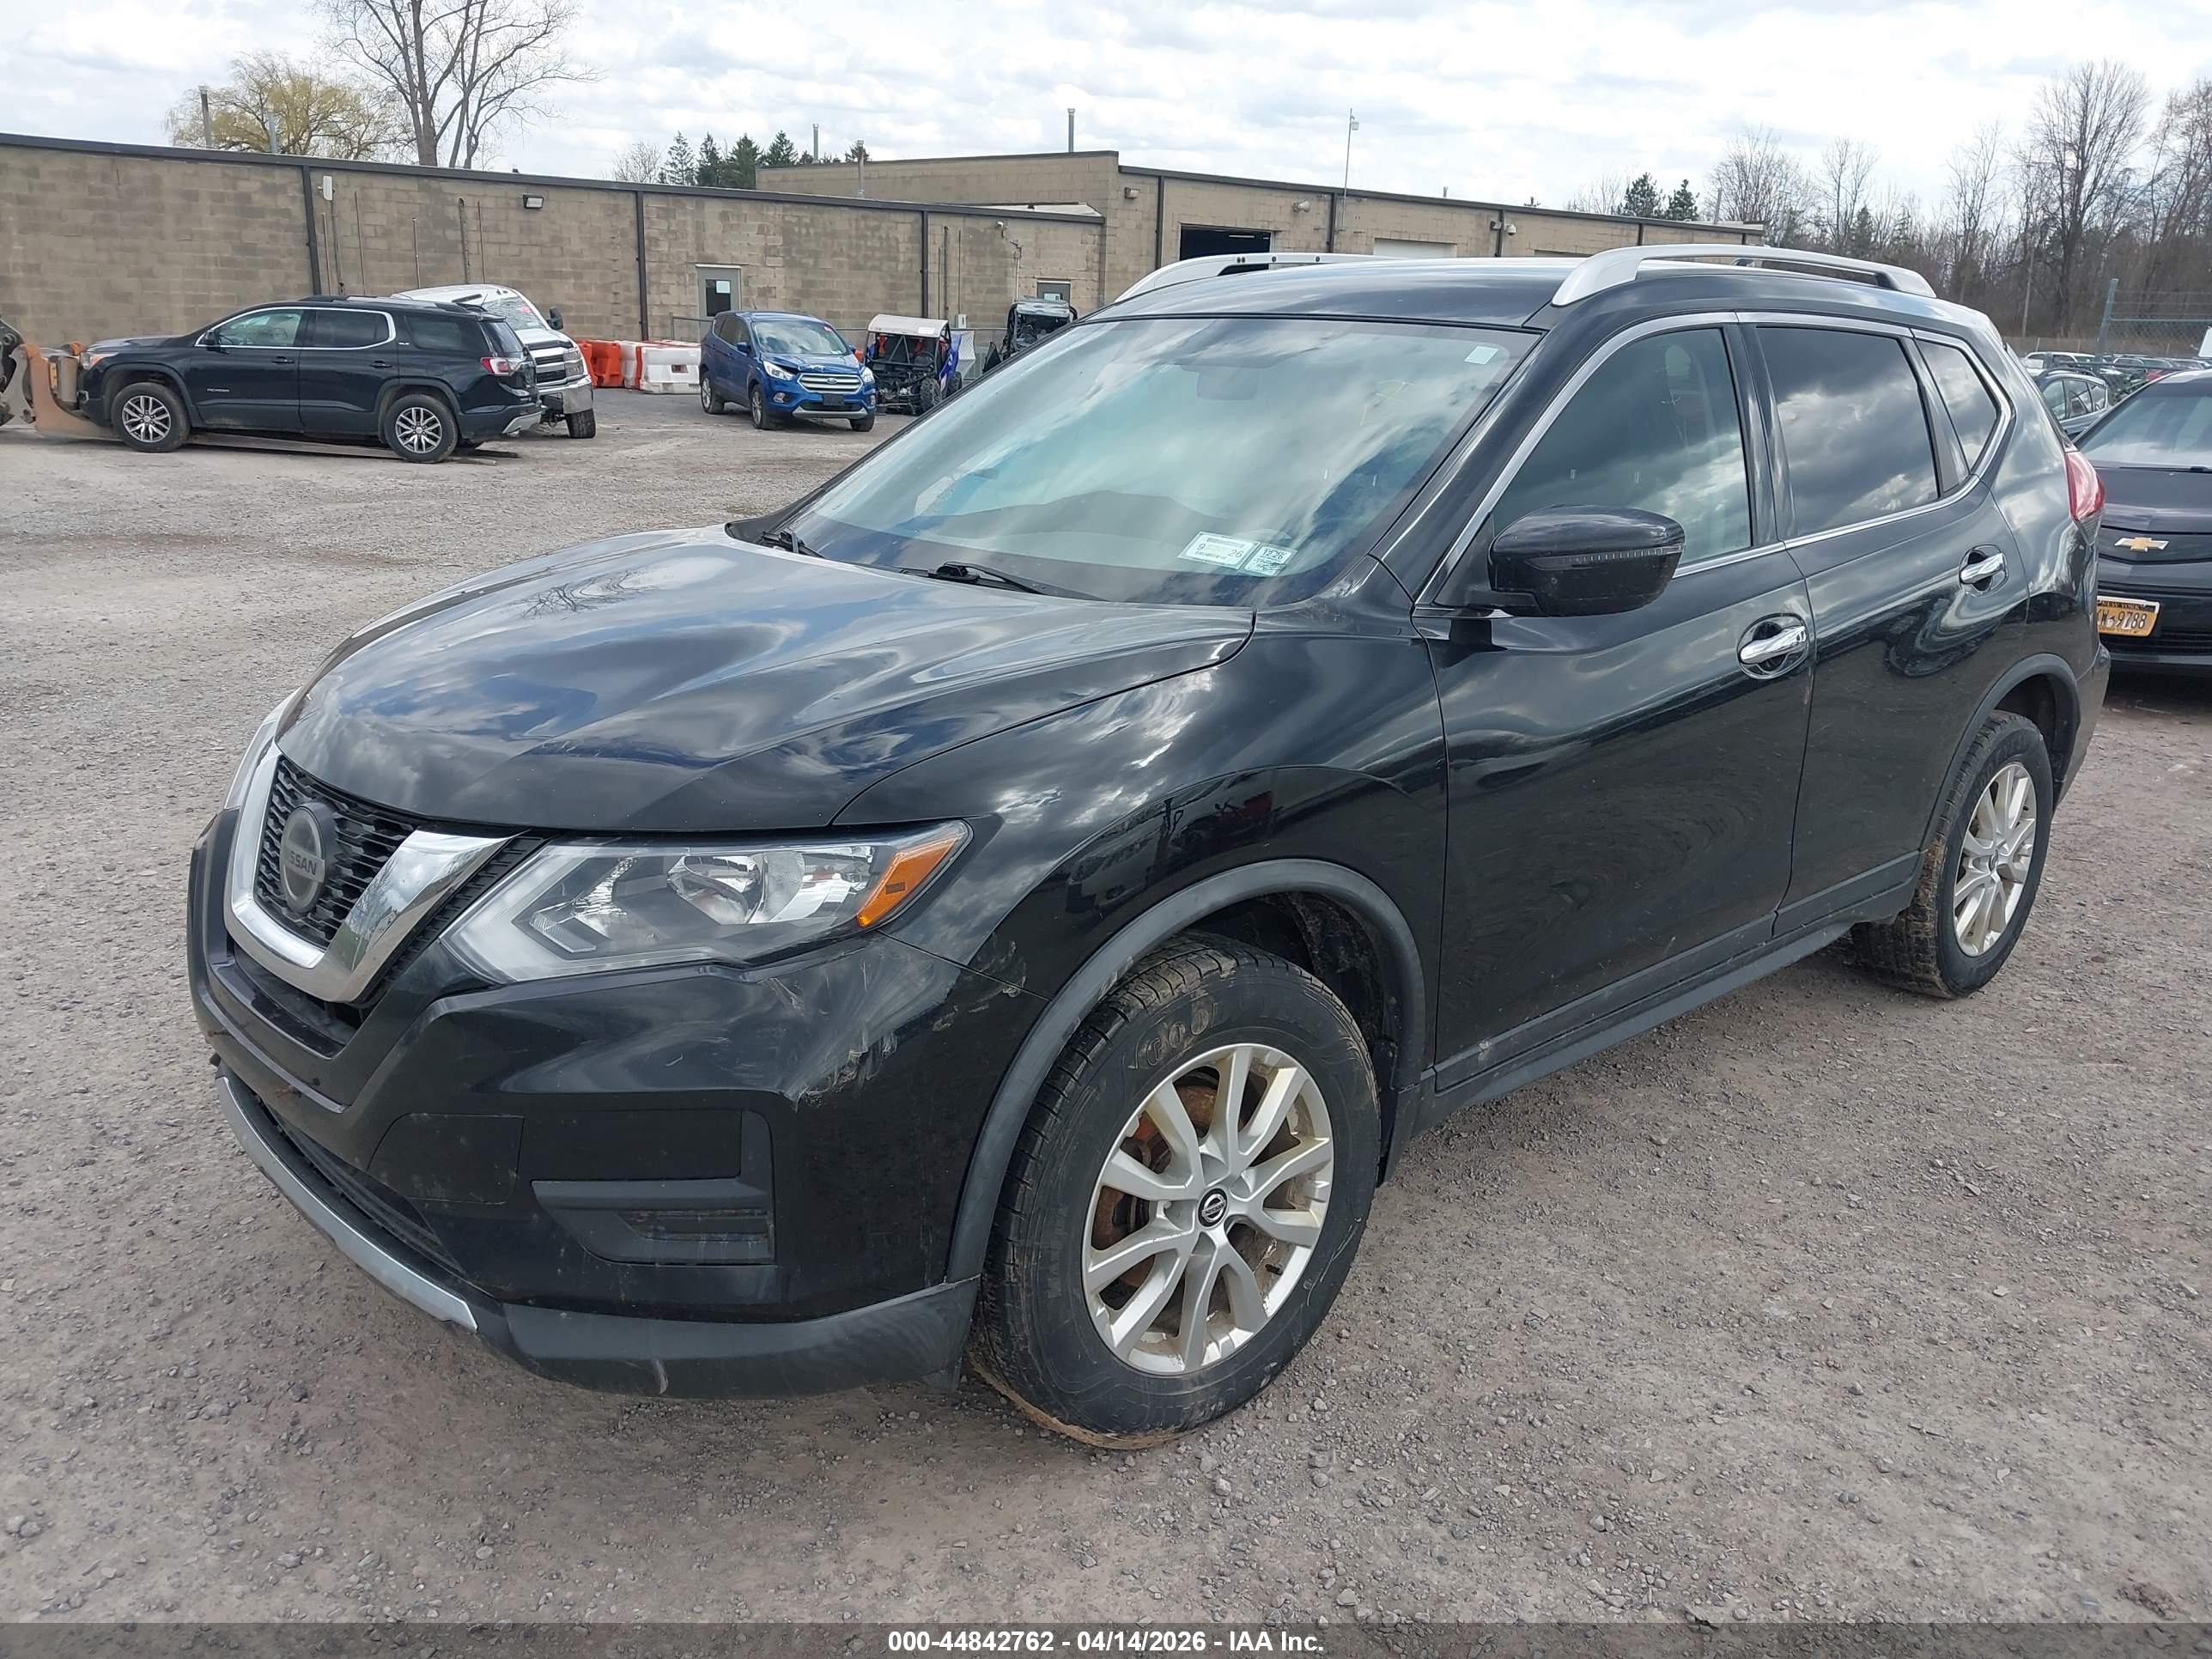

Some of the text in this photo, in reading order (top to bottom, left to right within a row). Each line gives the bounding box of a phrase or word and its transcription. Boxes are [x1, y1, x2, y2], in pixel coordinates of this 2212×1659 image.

[1196, 543, 1206, 551] 9
[1227, 549, 1244, 559] 26
[2116, 611, 2148, 629] 9788
[283, 846, 317, 876] SSAN
